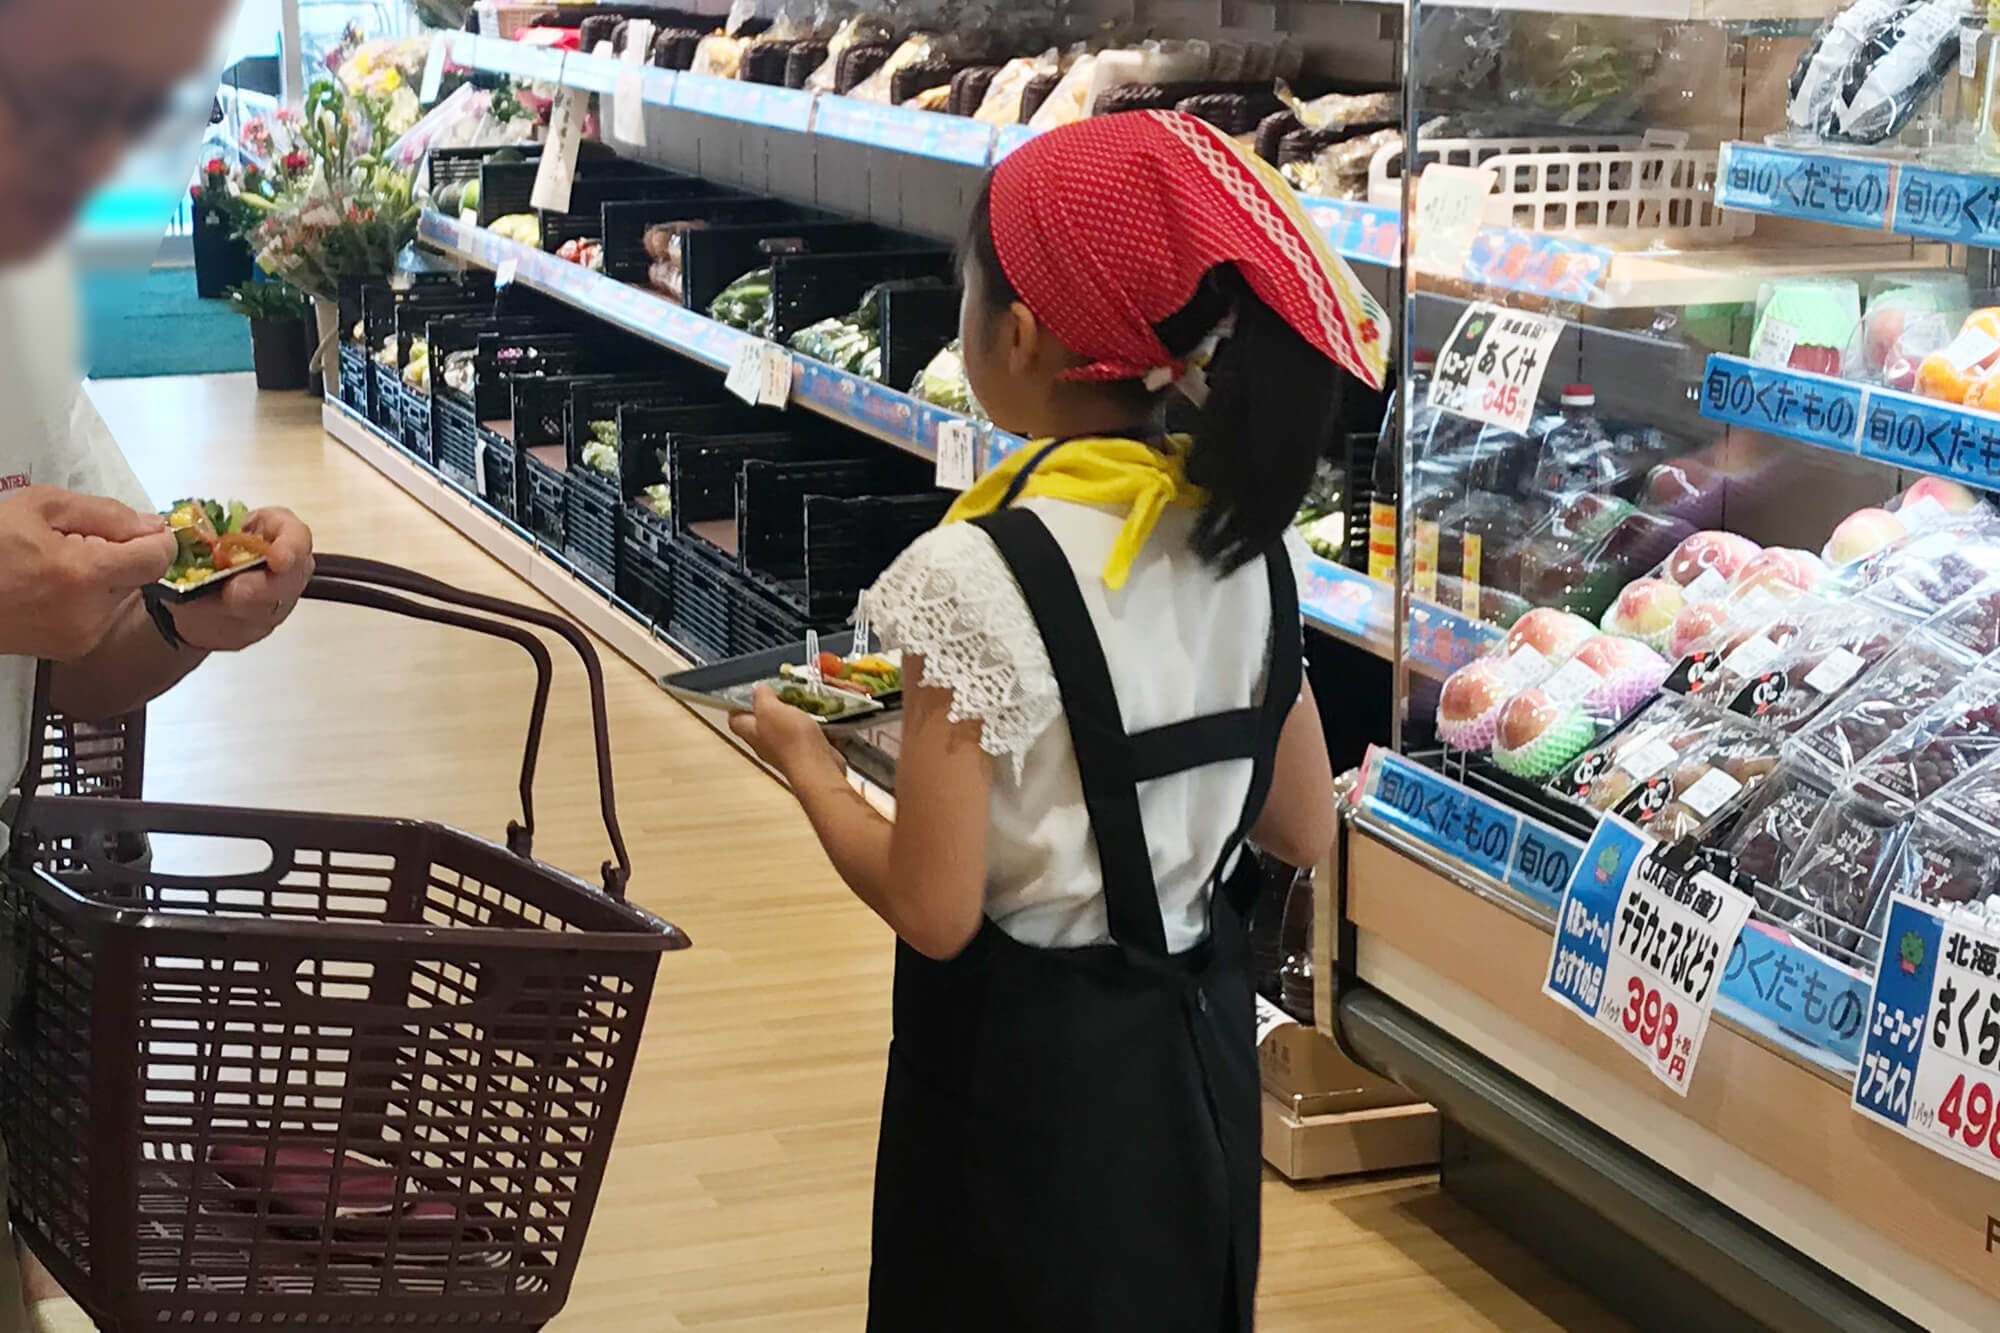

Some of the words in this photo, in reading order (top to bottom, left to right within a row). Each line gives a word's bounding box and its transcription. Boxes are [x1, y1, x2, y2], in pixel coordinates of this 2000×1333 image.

[1731, 160, 1884, 216] 旬のくだもの
[1478, 340, 1536, 386] あく汁
[1707, 367, 1855, 439] 旬のくだもの
[1555, 945, 1604, 1010] おすすめ品
[1945, 932, 2000, 978] 北海
[1622, 976, 1679, 1060] 398
[1871, 1001, 1925, 1053] エーコープ
[1932, 976, 2000, 1068] さくら
[1668, 1055, 1687, 1082] 円
[1860, 1050, 1912, 1117] プライス
